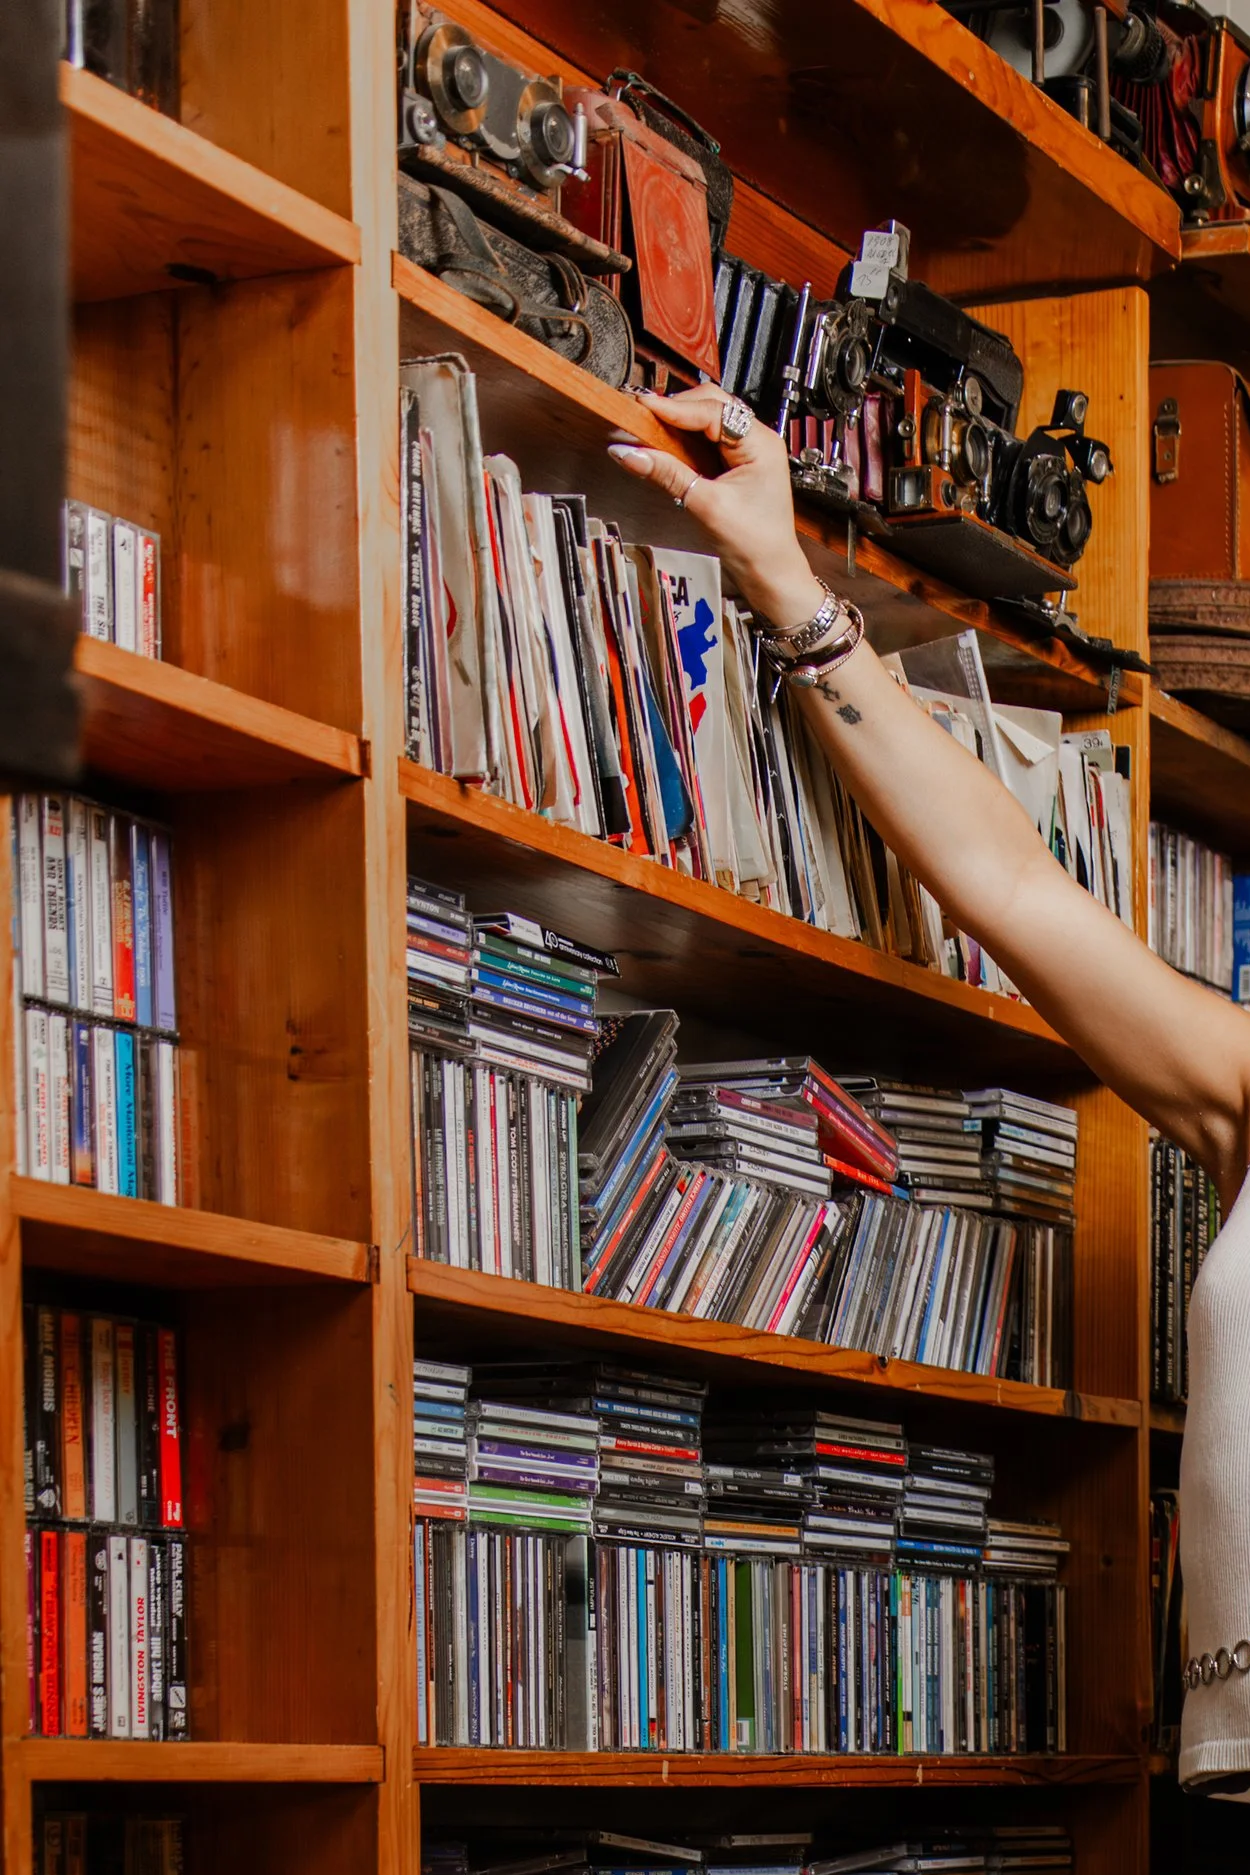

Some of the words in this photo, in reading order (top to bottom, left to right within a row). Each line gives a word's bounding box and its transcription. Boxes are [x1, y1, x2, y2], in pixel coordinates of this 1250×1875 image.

[560, 1182, 568, 1208] GYRA
[164, 1376, 177, 1439] FRONT
[137, 1597, 145, 1643] TAYLOR
[175, 1579, 183, 1618] KELLY
[92, 1632, 104, 1684] INGRAM
[150, 1636, 161, 1658] hill
[93, 1686, 106, 1731] JAMES
[137, 1650, 145, 1724] LIVINGSTON
